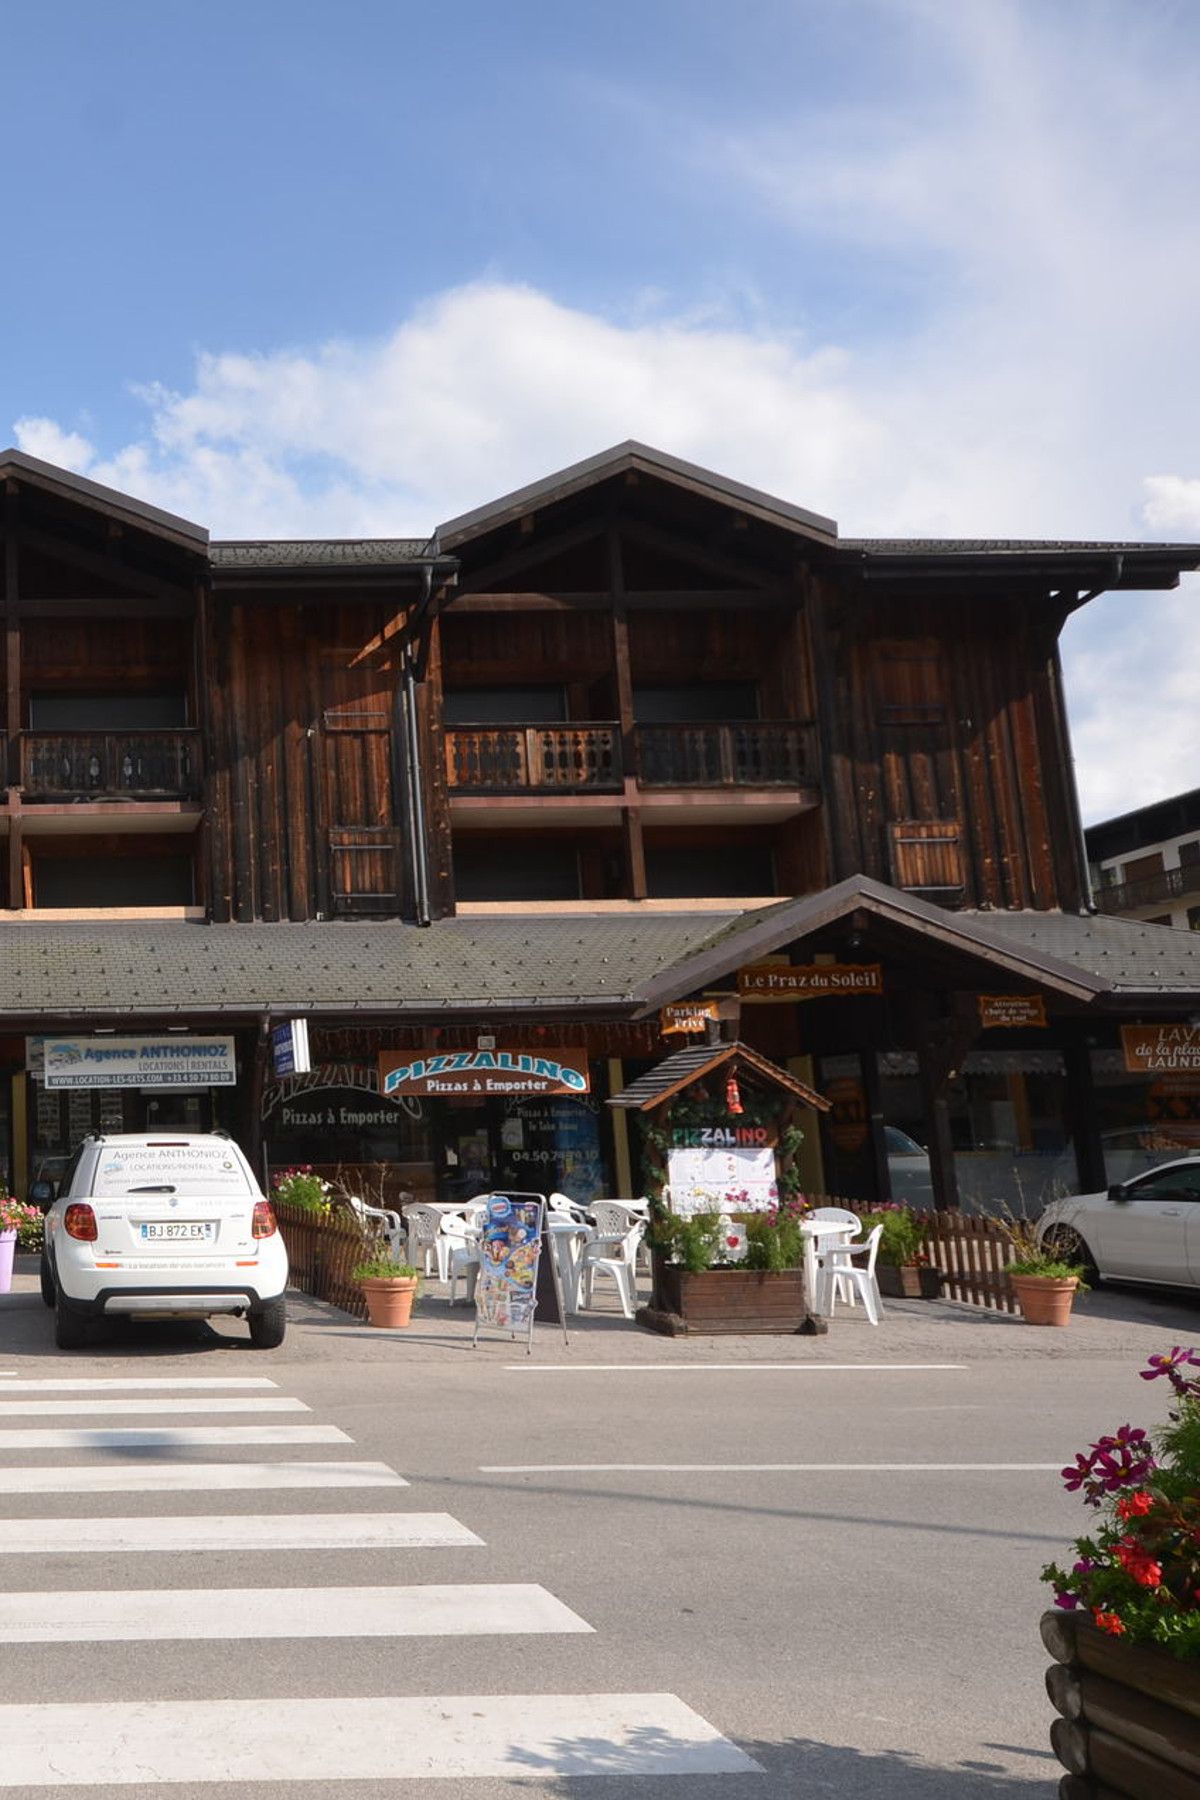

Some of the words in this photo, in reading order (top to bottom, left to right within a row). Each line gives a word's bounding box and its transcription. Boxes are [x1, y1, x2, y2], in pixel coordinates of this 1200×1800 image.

[744, 975, 765, 987] Le
[769, 975, 808, 987] Praz
[813, 975, 829, 987] du
[831, 972, 877, 987] Soleil
[666, 1006, 711, 1018] Parking
[1159, 1028, 1200, 1042] LAV
[84, 1047, 137, 1062] Agence
[139, 1045, 228, 1059] ANTHONIOZ
[1155, 1041, 1171, 1056] la
[138, 1060, 185, 1071] LOCATIONS
[190, 1059, 229, 1070] RENTALS
[384, 1052, 587, 1093] PIZZALINO
[426, 1079, 468, 1092] Pizzas
[473, 1078, 482, 1091] à
[486, 1078, 549, 1092] Emporter
[282, 1107, 323, 1125] Pizzas
[327, 1107, 338, 1125] à
[340, 1107, 400, 1126] Emporter
[673, 1127, 768, 1144] PIZZALINO
[113, 1151, 156, 1161] Agence
[149, 1225, 164, 1237] BJ
[167, 1225, 188, 1237] 872
[190, 1225, 204, 1237] EK
